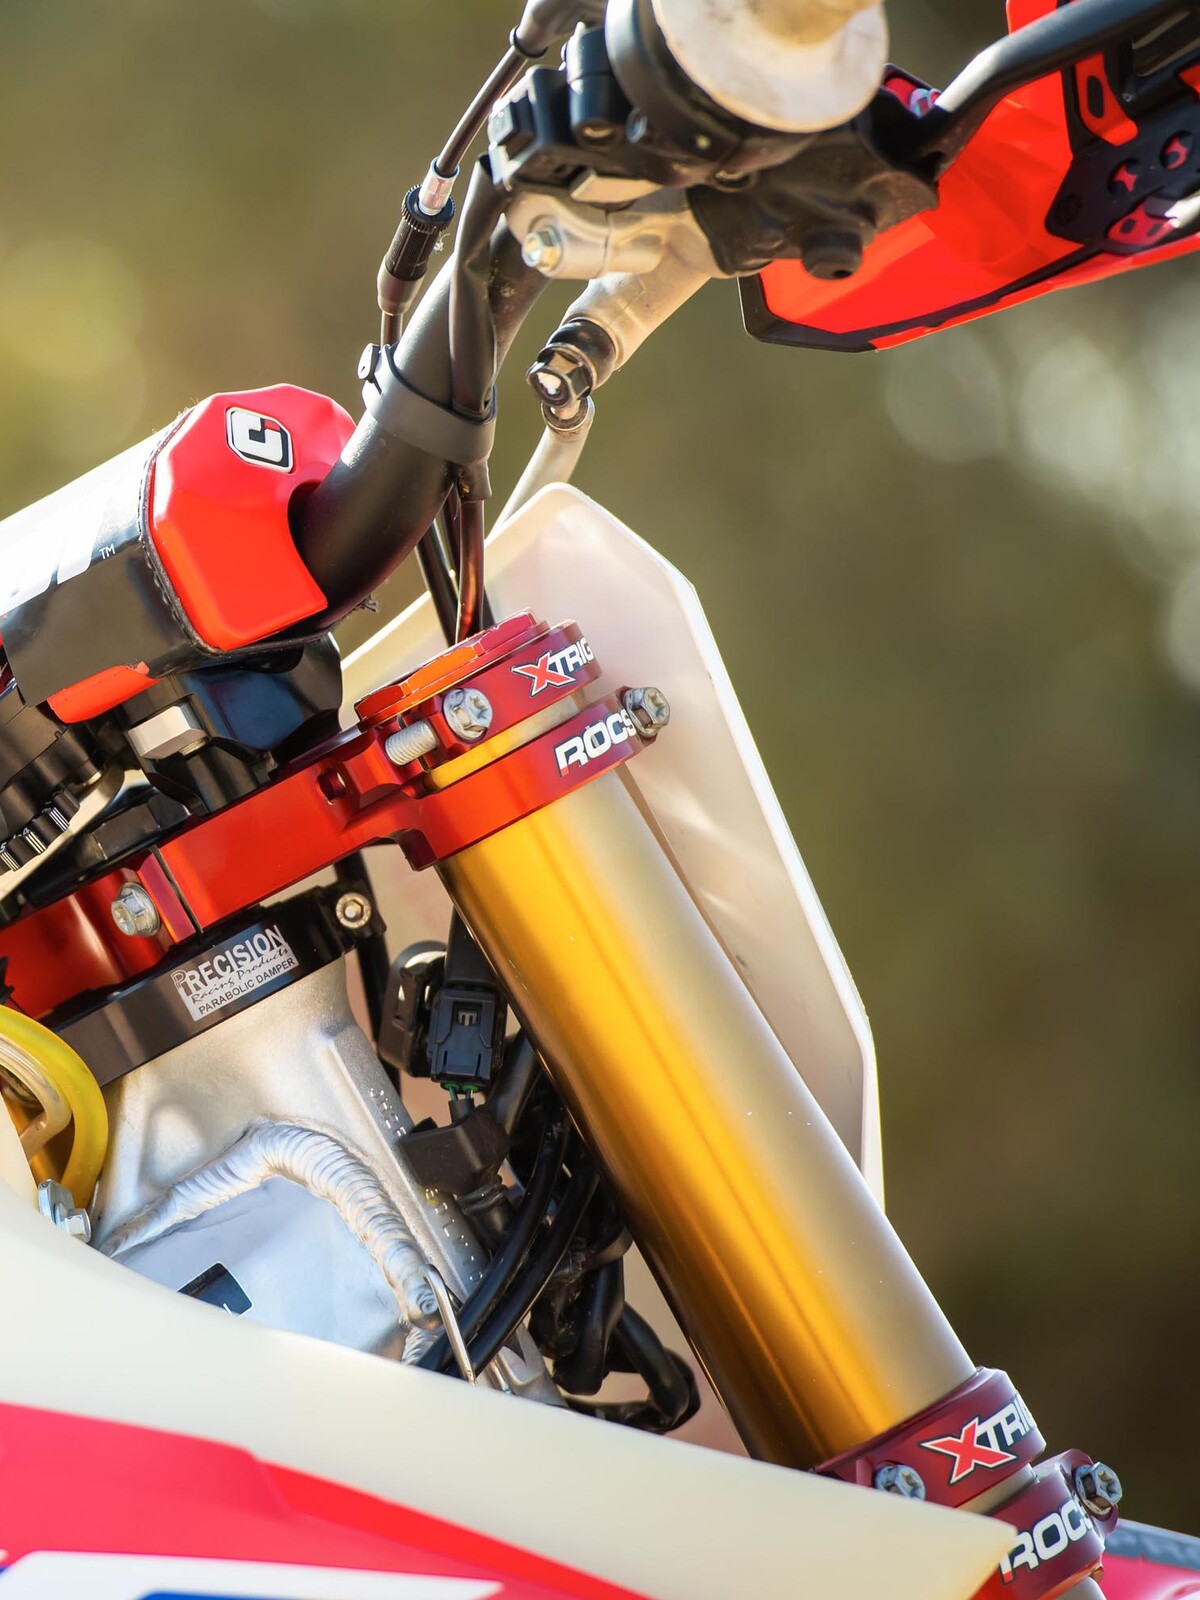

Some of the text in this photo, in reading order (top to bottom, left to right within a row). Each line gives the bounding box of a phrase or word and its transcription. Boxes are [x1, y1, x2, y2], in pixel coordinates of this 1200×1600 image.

[170, 925, 287, 996] PRECISION
[191, 947, 288, 1004] Racing Products
[199, 957, 295, 1014] PARABOLIC DAMPER
